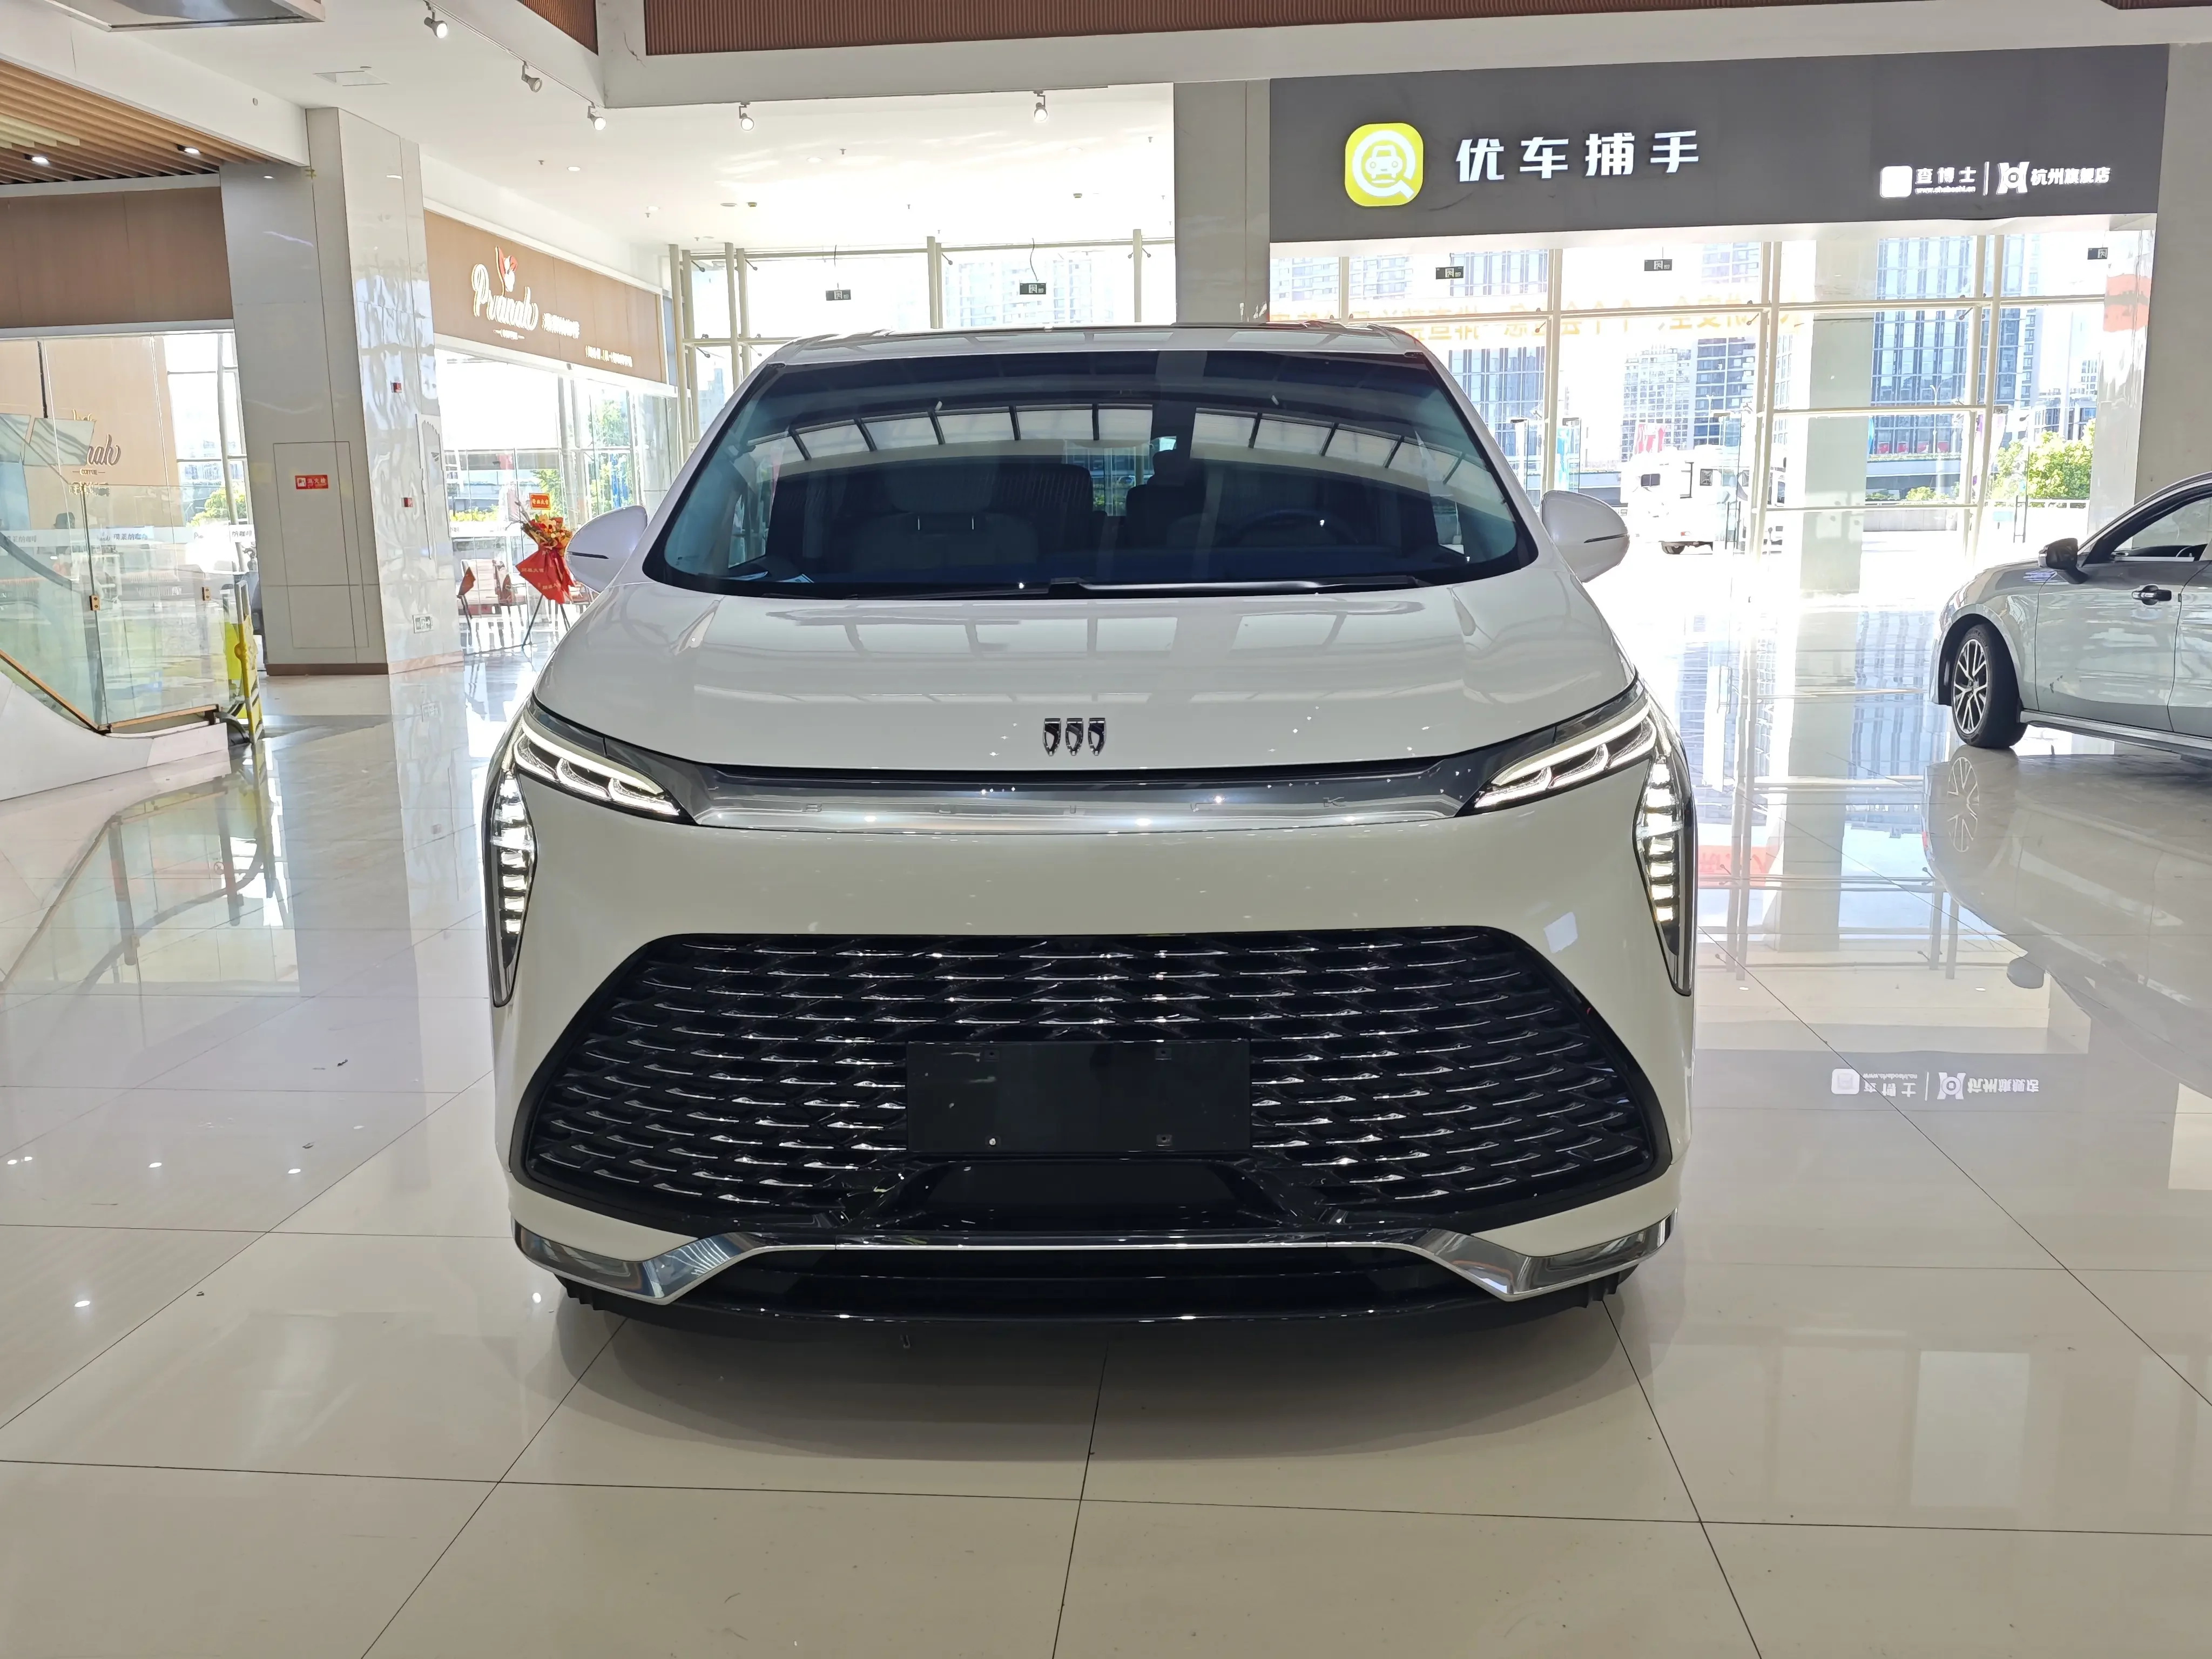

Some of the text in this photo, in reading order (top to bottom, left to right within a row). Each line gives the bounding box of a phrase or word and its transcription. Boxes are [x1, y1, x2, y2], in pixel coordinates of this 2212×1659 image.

[1456, 130, 1699, 183] 优车捕手
[1915, 167, 1977, 184] 查博士
[2031, 166, 2111, 186] 杭州旗舰店
